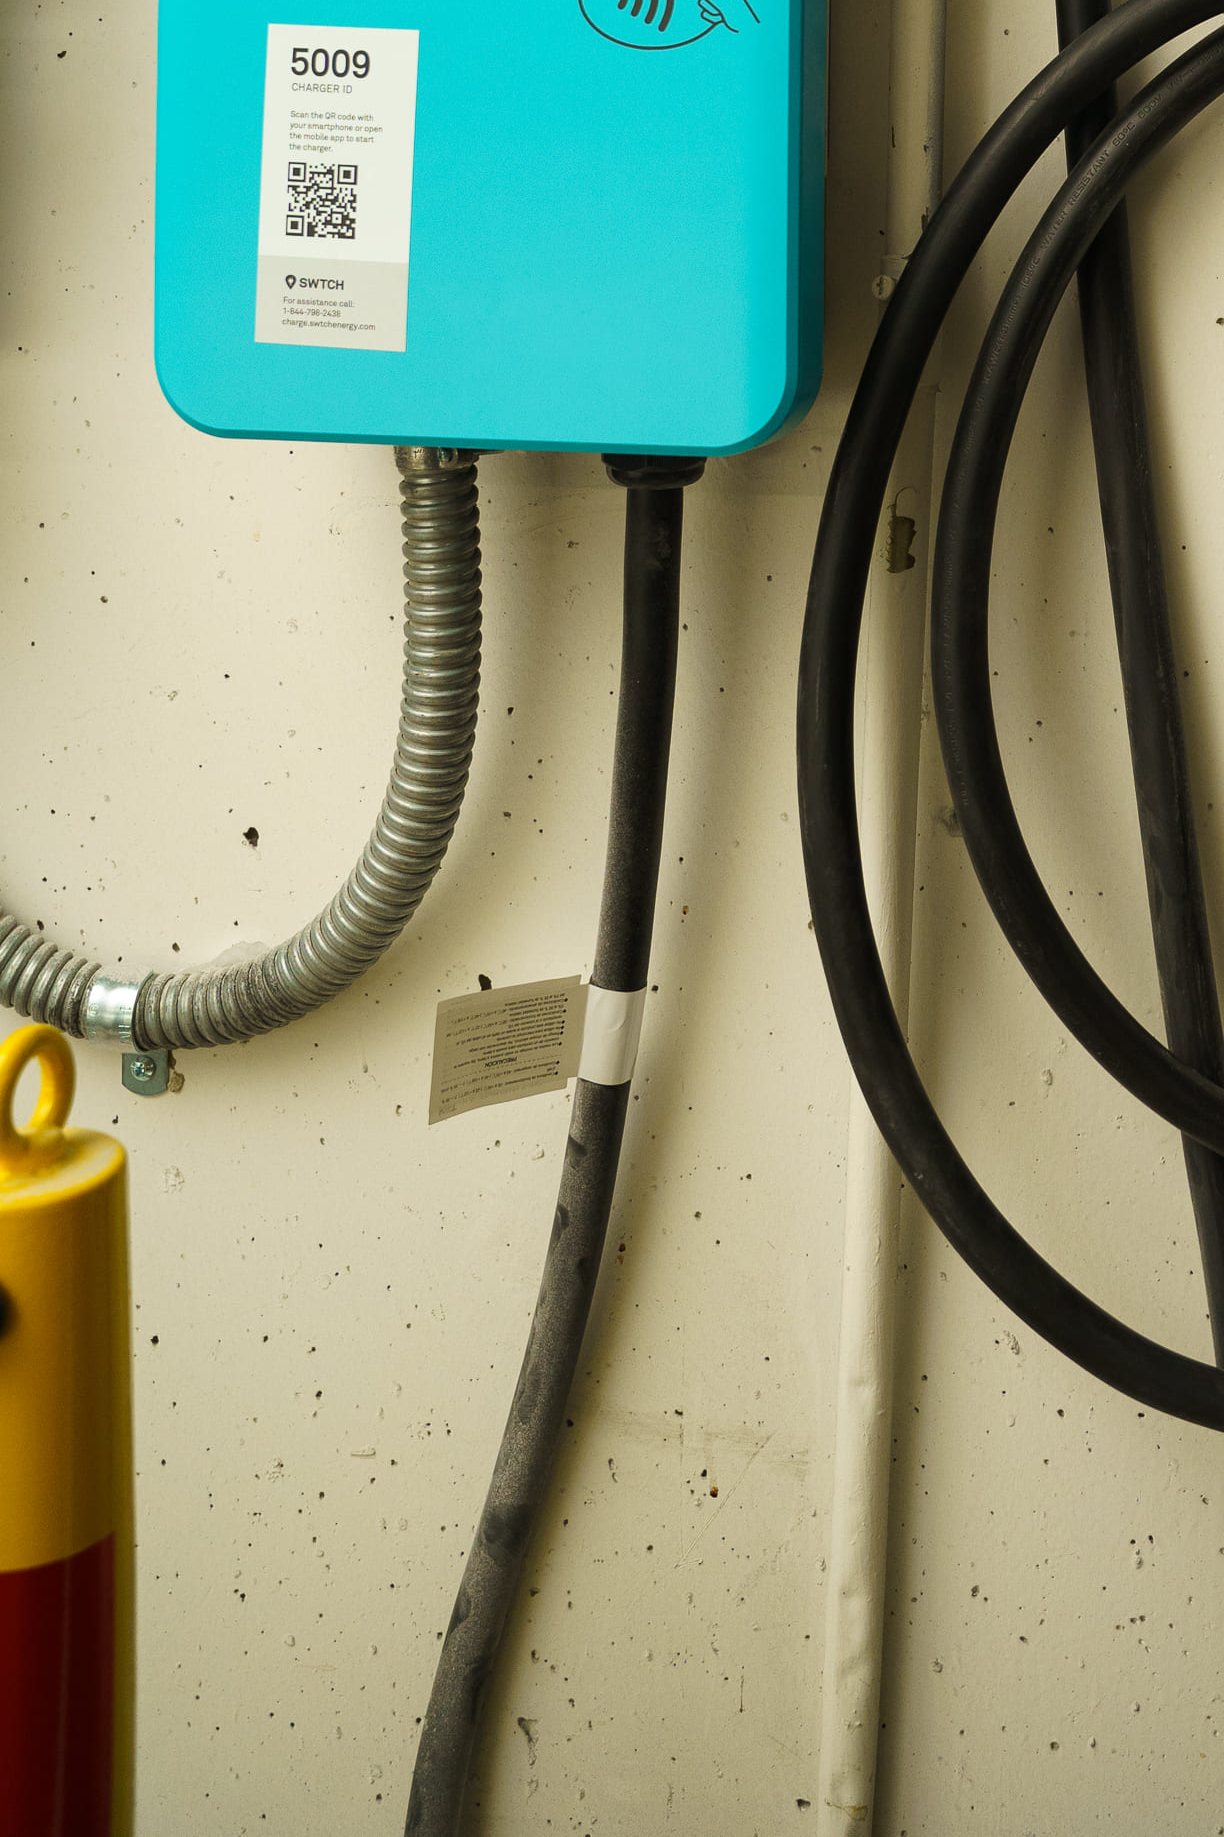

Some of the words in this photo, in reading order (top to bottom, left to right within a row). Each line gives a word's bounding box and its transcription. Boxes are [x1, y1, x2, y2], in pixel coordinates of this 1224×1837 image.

[291, 47, 371, 79] 5009
[291, 82, 340, 93] CHARGER
[343, 85, 353, 94] ID
[290, 110, 309, 118] Scan
[325, 112, 336, 120] QR
[337, 113, 356, 121] code
[357, 114, 374, 122] with
[289, 122, 306, 130] your
[308, 123, 353, 132] smartphone
[364, 126, 383, 134] open
[303, 133, 328, 141] mobile
[330, 135, 344, 143] app
[289, 143, 301, 151] the
[302, 143, 333, 154] charger.
[1040, 211, 1067, 250] WATER
[1068, 150, 1110, 207] RESISTANT
[299, 277, 345, 290] SWTCH
[283, 296, 295, 304] For
[297, 298, 337, 307] assistance
[282, 318, 376, 331] charge.swtchenergy.com
